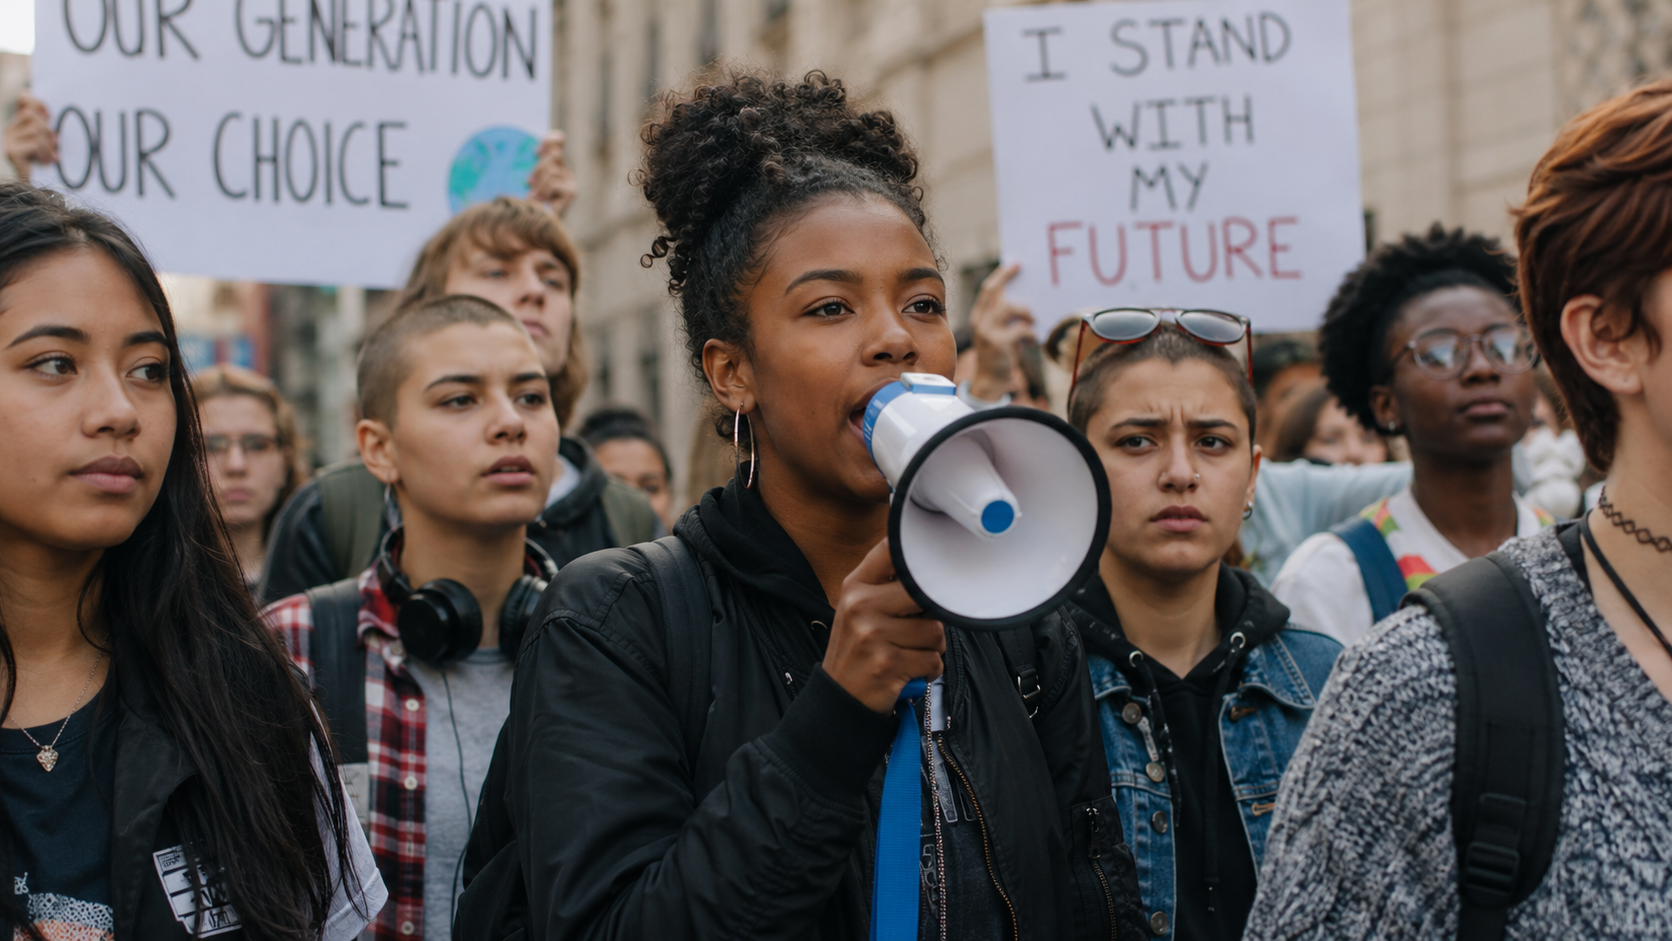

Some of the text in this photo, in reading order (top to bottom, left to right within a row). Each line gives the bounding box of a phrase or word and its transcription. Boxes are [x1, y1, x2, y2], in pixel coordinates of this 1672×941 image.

[62, 0, 538, 80] OUR GENERATION
[1023, 11, 1292, 82] I STAND
[56, 106, 410, 210] OUR CHOICE
[1091, 95, 1255, 151] WITH
[1129, 162, 1209, 212] MY
[1047, 216, 1302, 287] FUTURE
